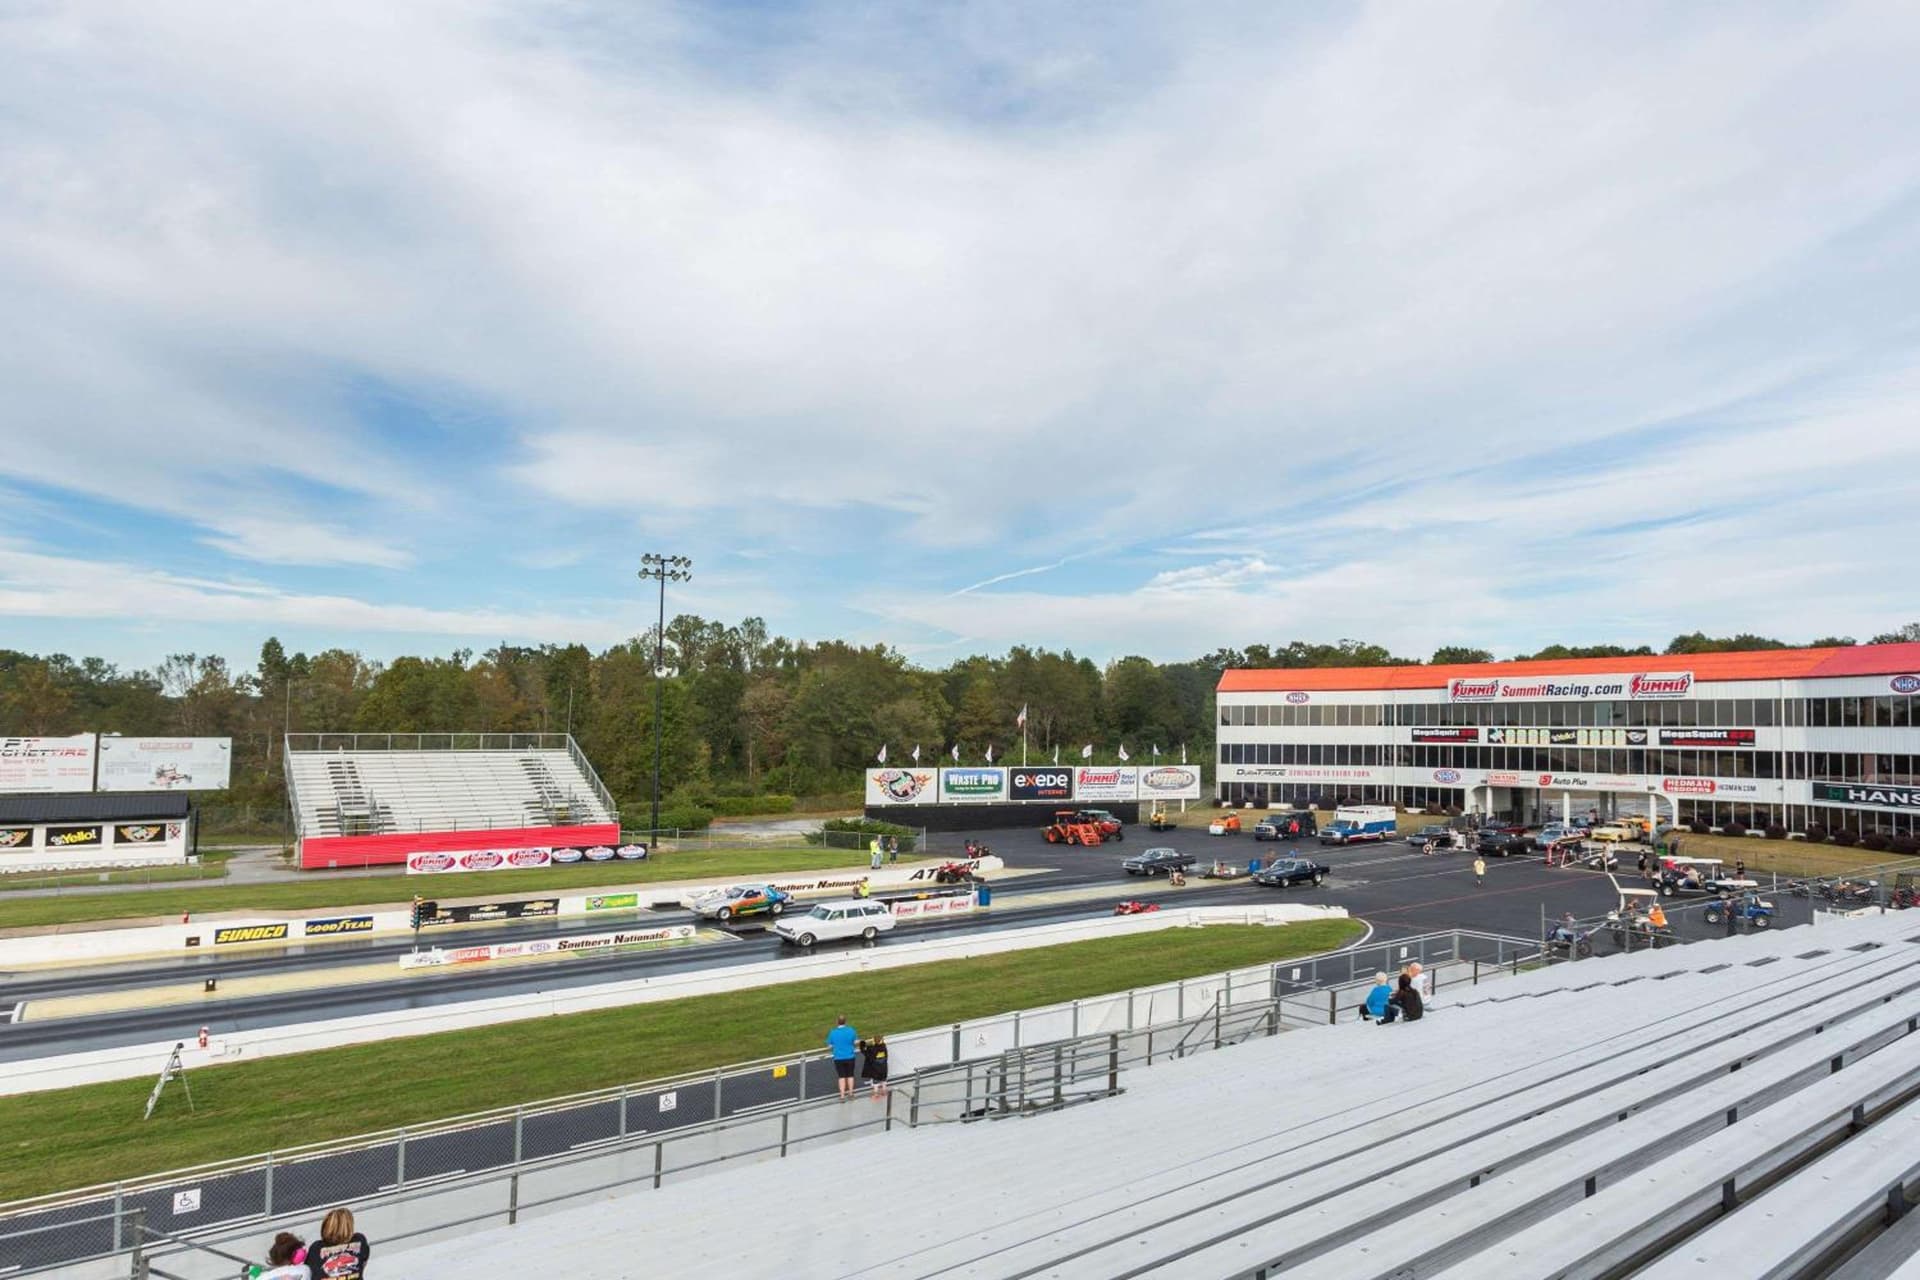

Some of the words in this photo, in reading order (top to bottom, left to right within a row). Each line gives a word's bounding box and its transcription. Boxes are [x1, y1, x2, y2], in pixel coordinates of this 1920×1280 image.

[1501, 683, 1623, 698] SummitRacing.com
[1894, 679, 1920, 690] NHRA
[1661, 730, 1728, 739] MegaSquirt
[949, 774, 978, 785] WASTE
[1552, 777, 1571, 785] Auto
[1571, 777, 1588, 786] Plus
[1667, 779, 1711, 788] HEDMAN
[910, 860, 980, 881] ATTA
[305, 919, 373, 933] GOODYEAR
[216, 925, 286, 943] SUNOCO
[557, 938, 611, 950] Southern
[614, 932, 664, 945] Nationals
